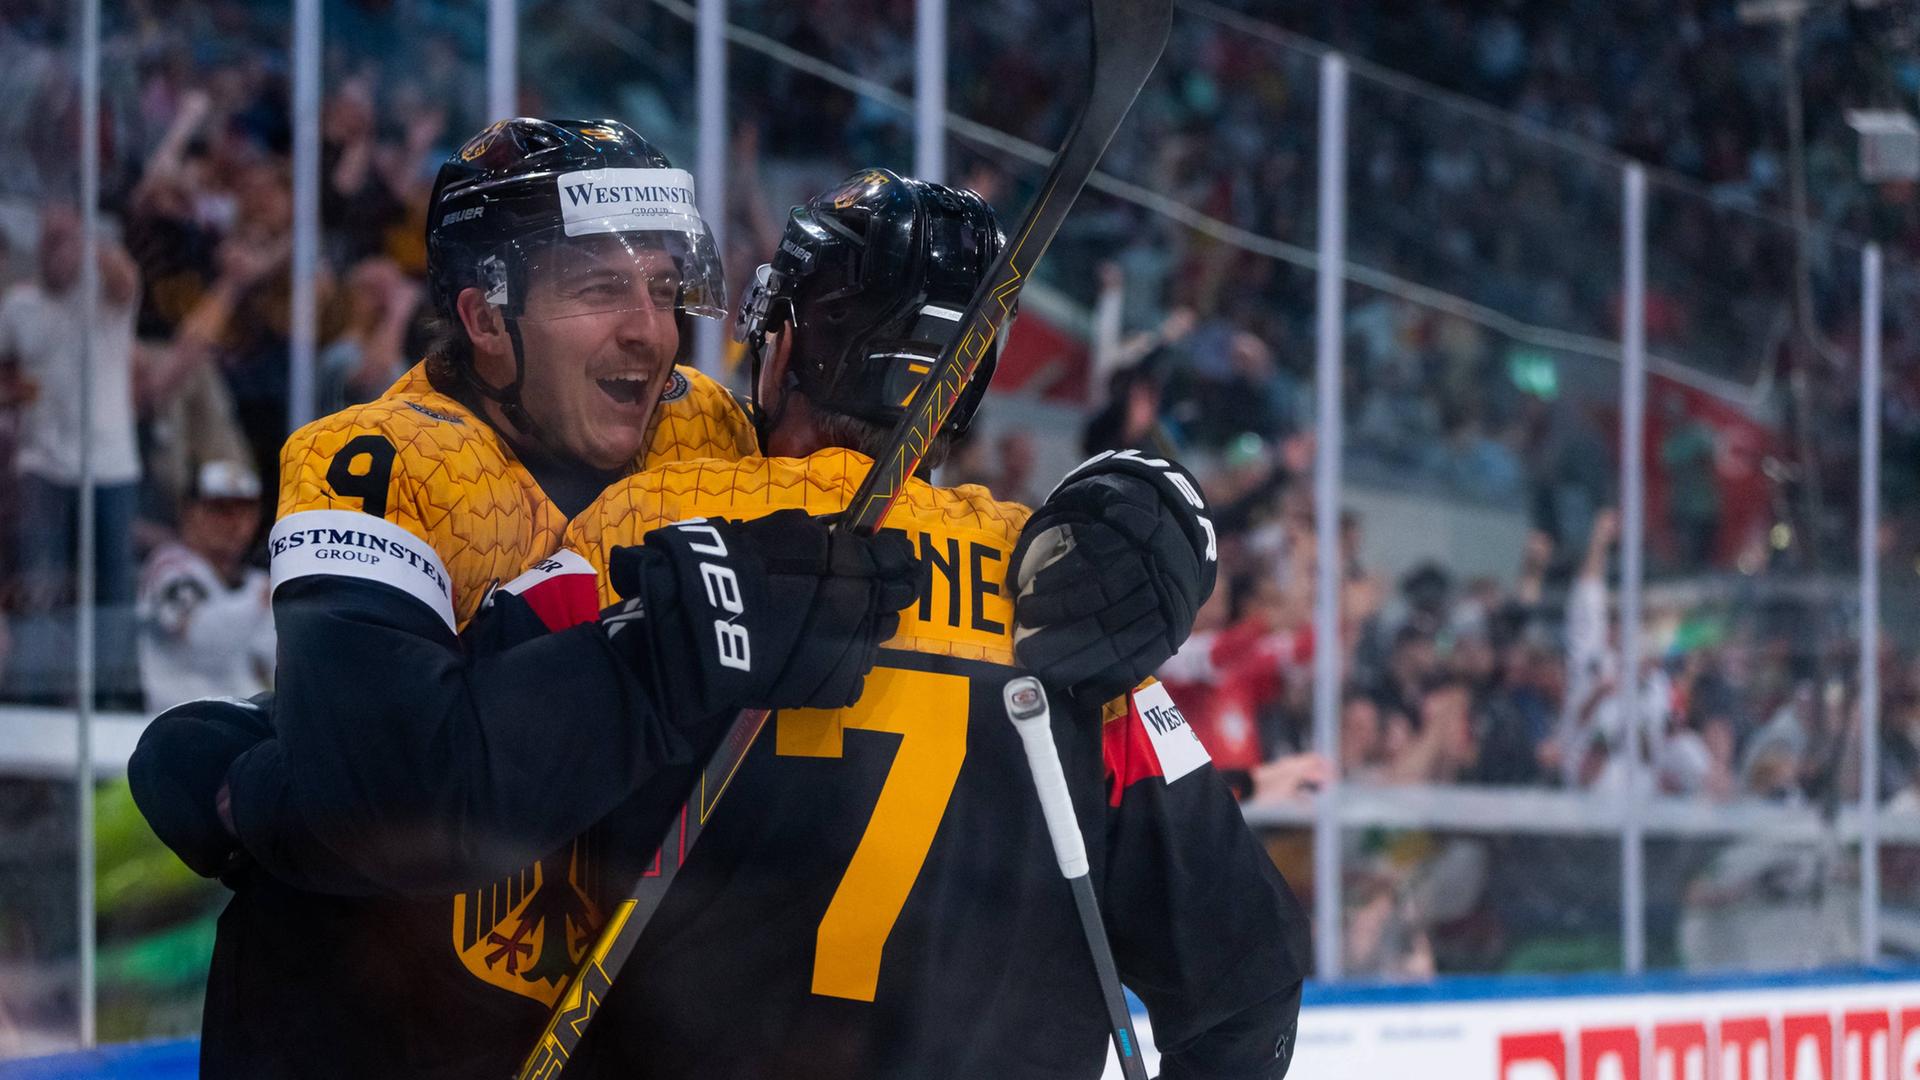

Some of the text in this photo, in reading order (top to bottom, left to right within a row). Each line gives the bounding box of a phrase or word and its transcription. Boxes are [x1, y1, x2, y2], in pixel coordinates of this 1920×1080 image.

[631, 207, 669, 218] GROUP
[326, 434, 397, 519] 9
[271, 528, 449, 600] ESTMINSTER
[315, 549, 380, 565] GROUP
[672, 516, 751, 672] BAU
[776, 665, 970, 1003] 7
